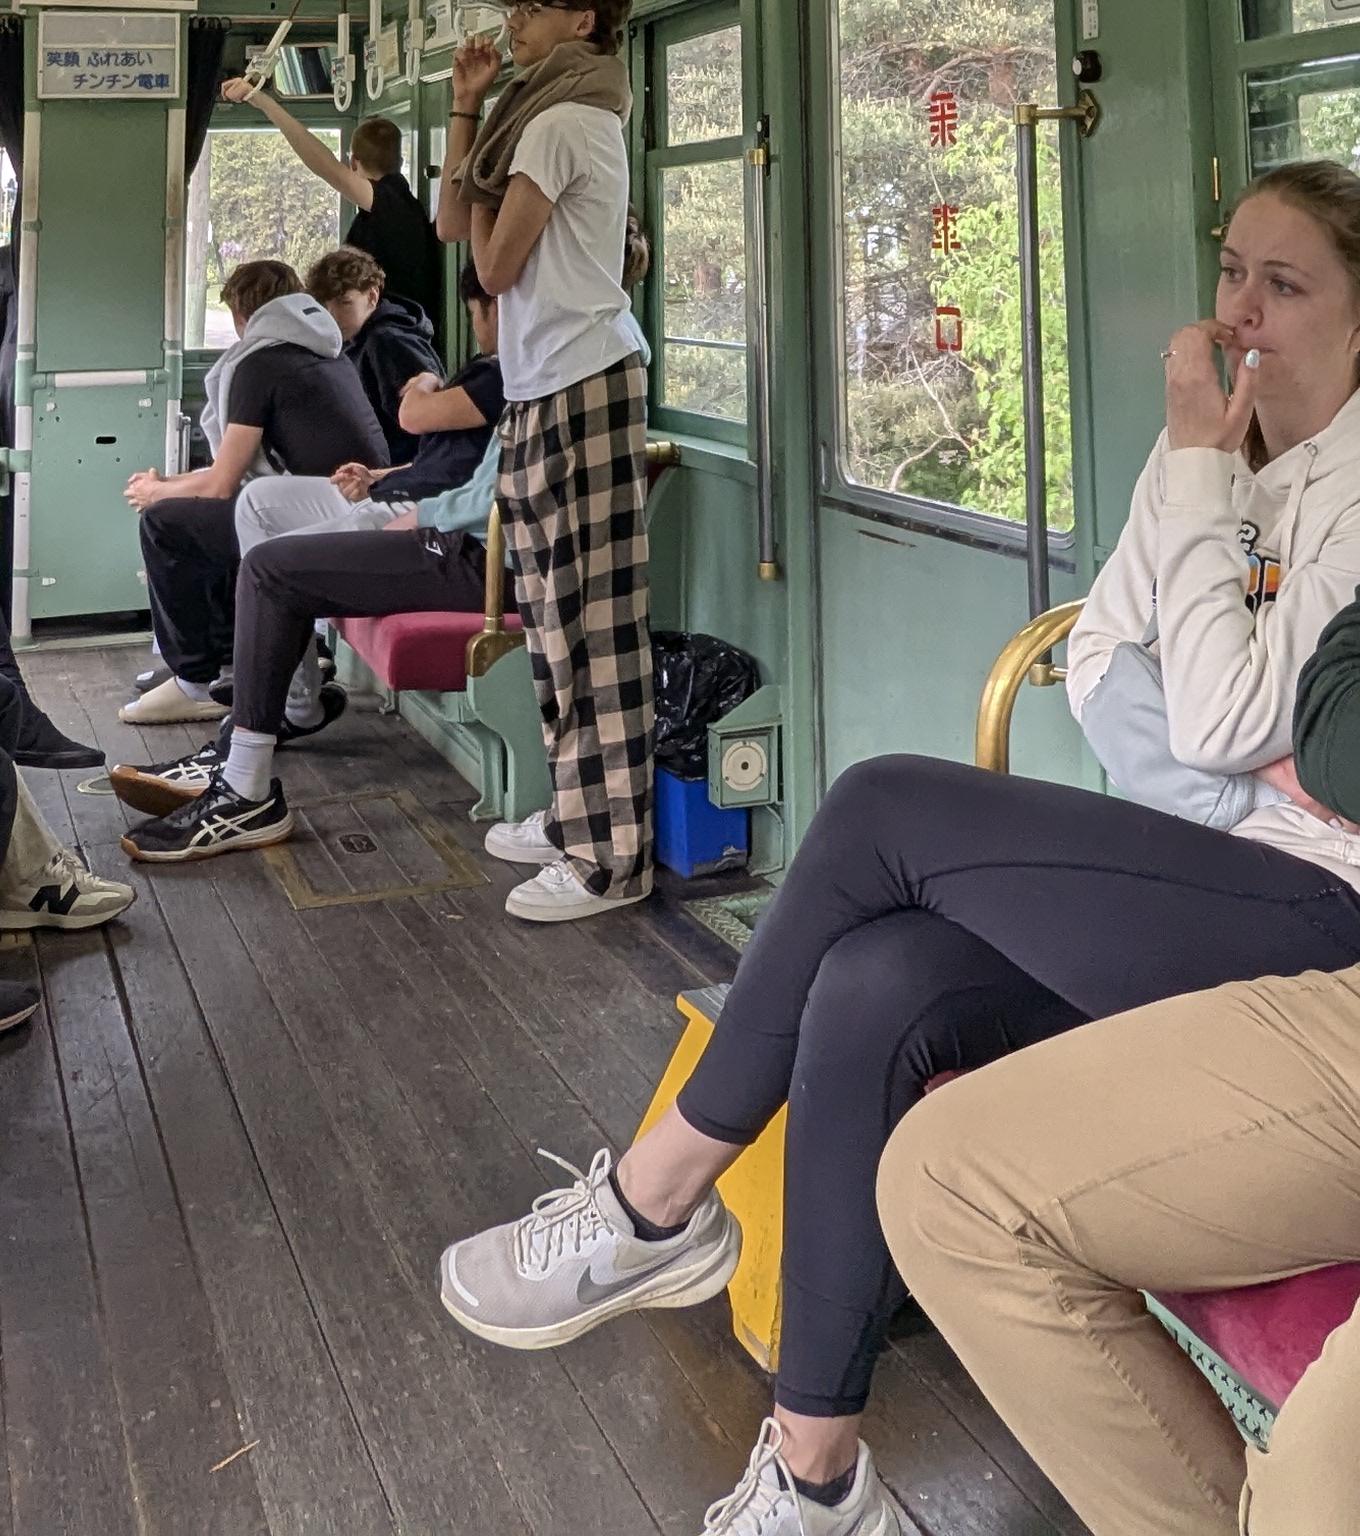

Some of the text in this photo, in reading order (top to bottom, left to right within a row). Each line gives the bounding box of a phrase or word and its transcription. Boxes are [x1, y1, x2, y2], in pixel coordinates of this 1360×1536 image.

[73, 72, 169, 90] チンチン電車
